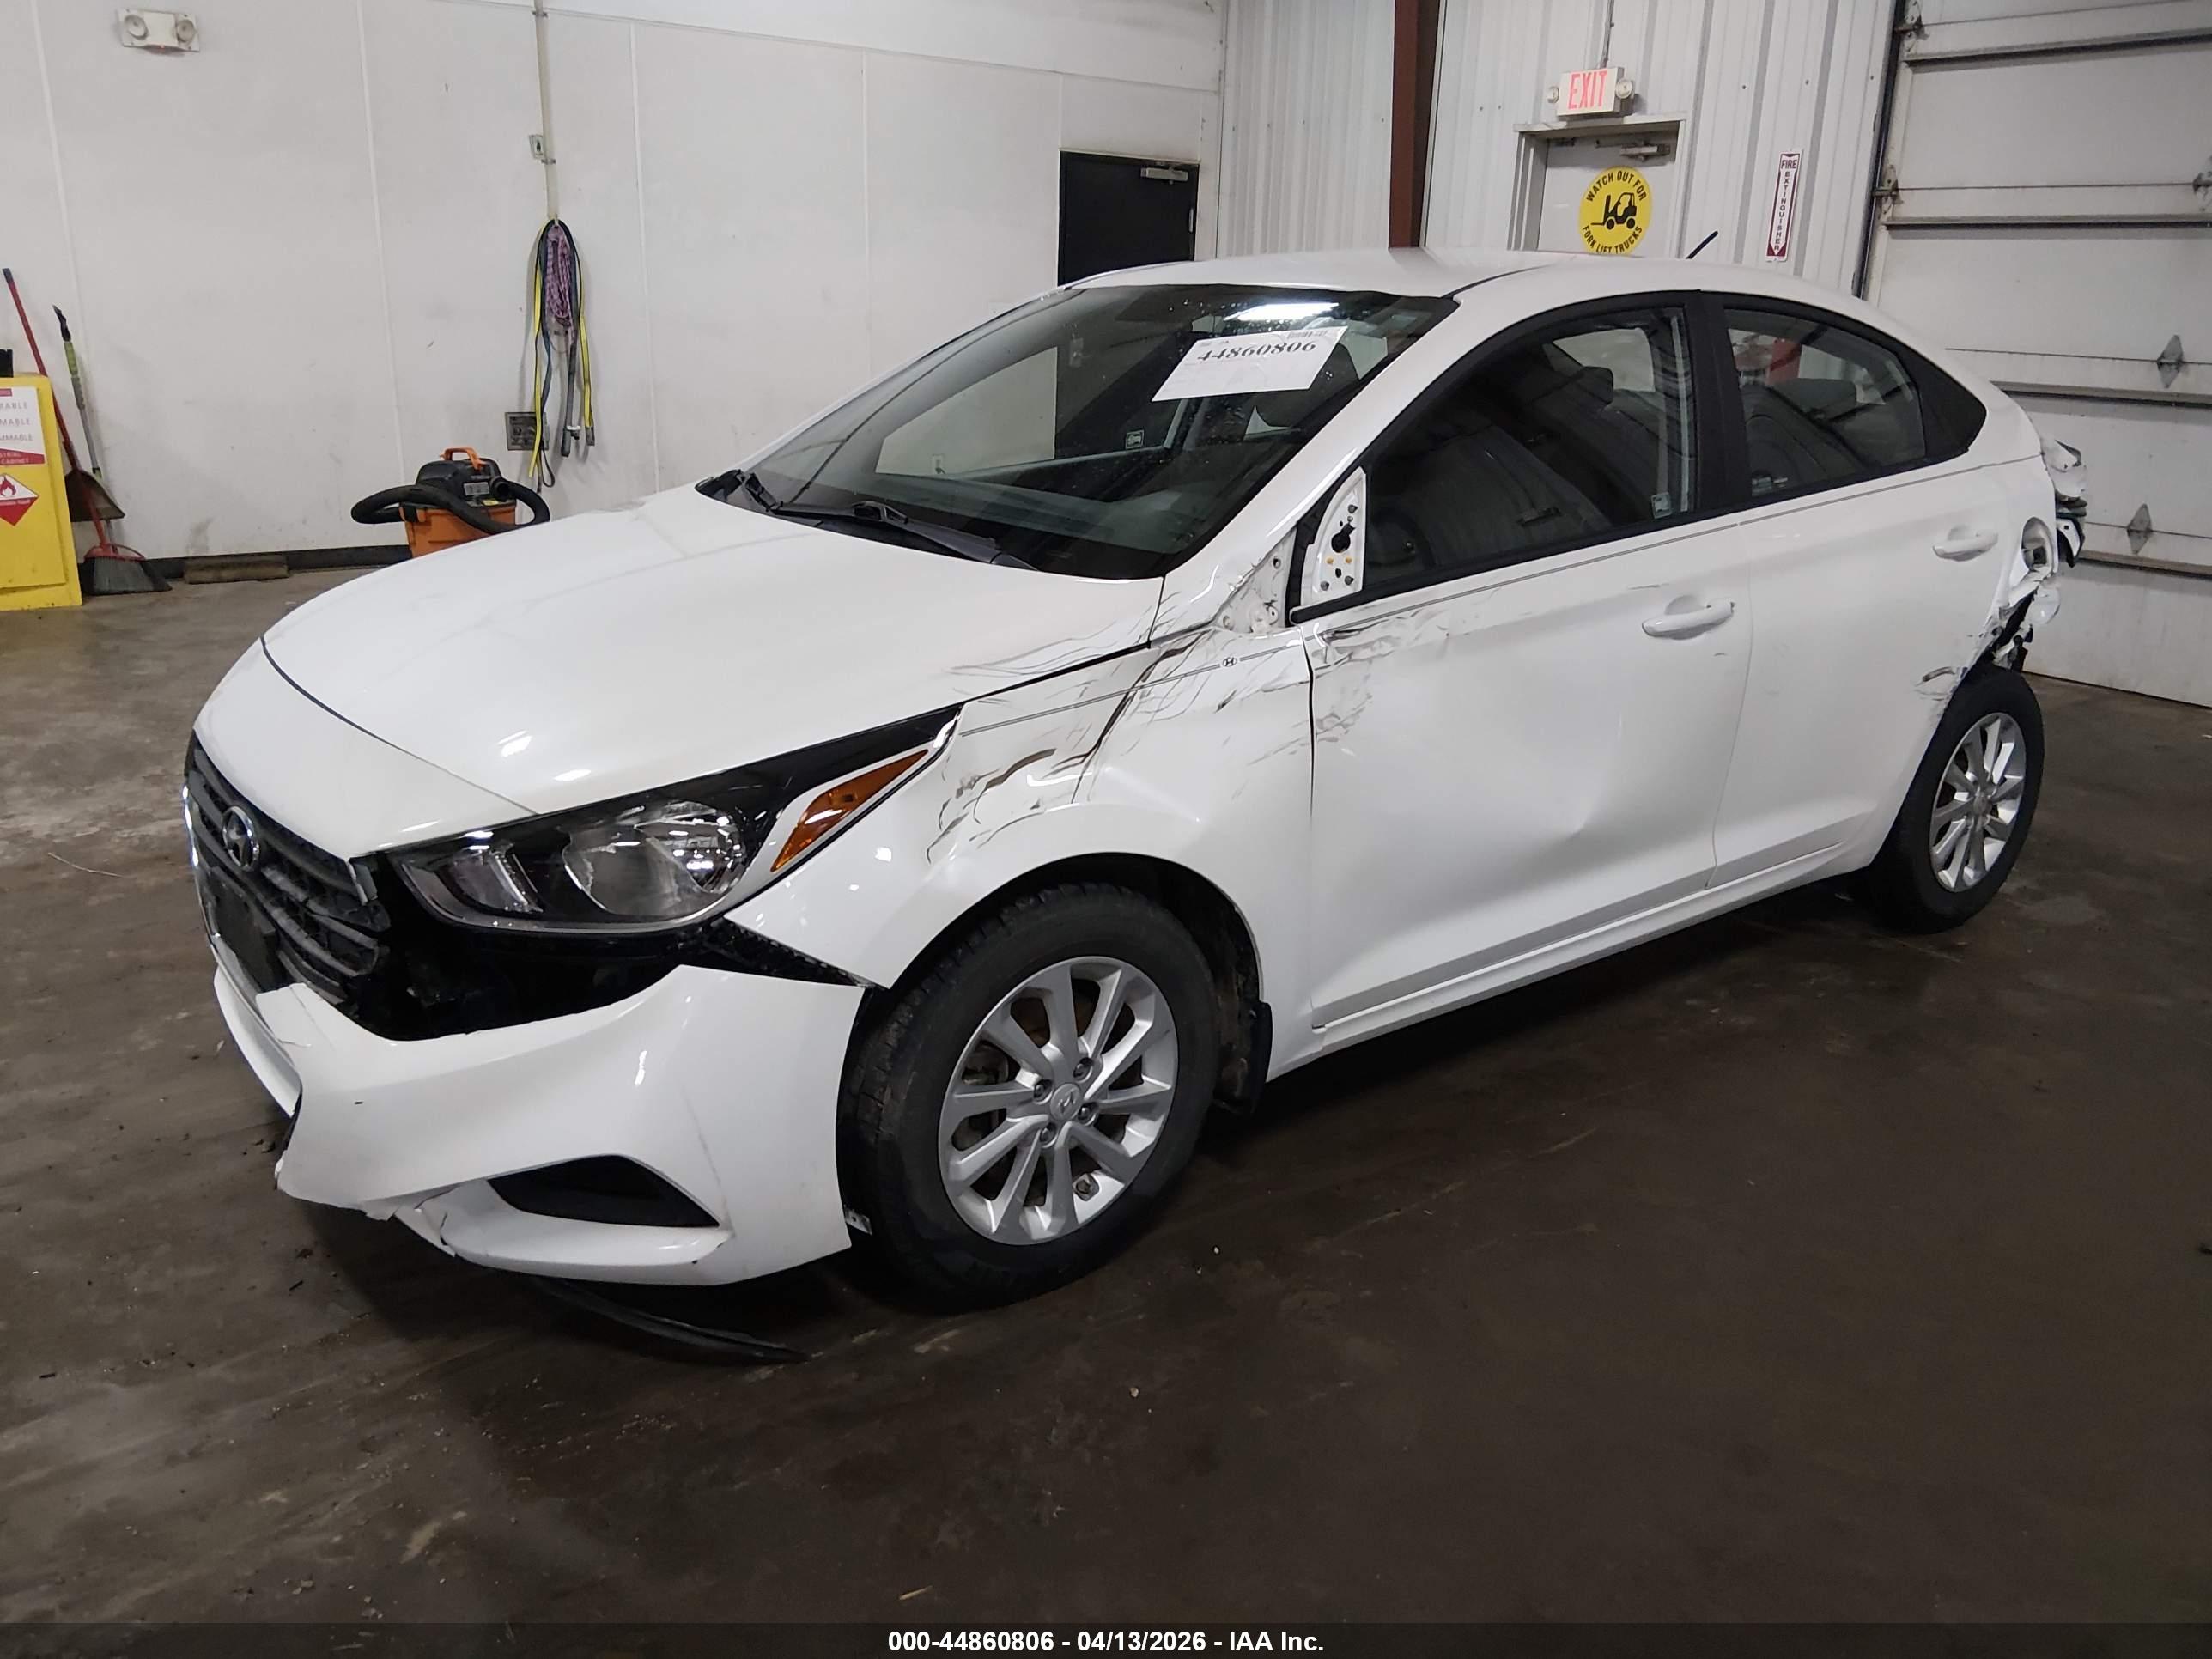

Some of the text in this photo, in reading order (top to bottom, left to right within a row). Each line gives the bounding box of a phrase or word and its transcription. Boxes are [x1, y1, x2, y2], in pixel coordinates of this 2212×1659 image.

[1568, 70, 1607, 110] EXIT
[1781, 160, 1797, 169] FIRE
[1586, 171, 1647, 202] WATCH OUT FOR
[1774, 172, 1790, 251] EXTINGUISHER
[1583, 225, 1643, 254] FORK LIFT TRUCKS
[1197, 341, 1316, 361] 44860806
